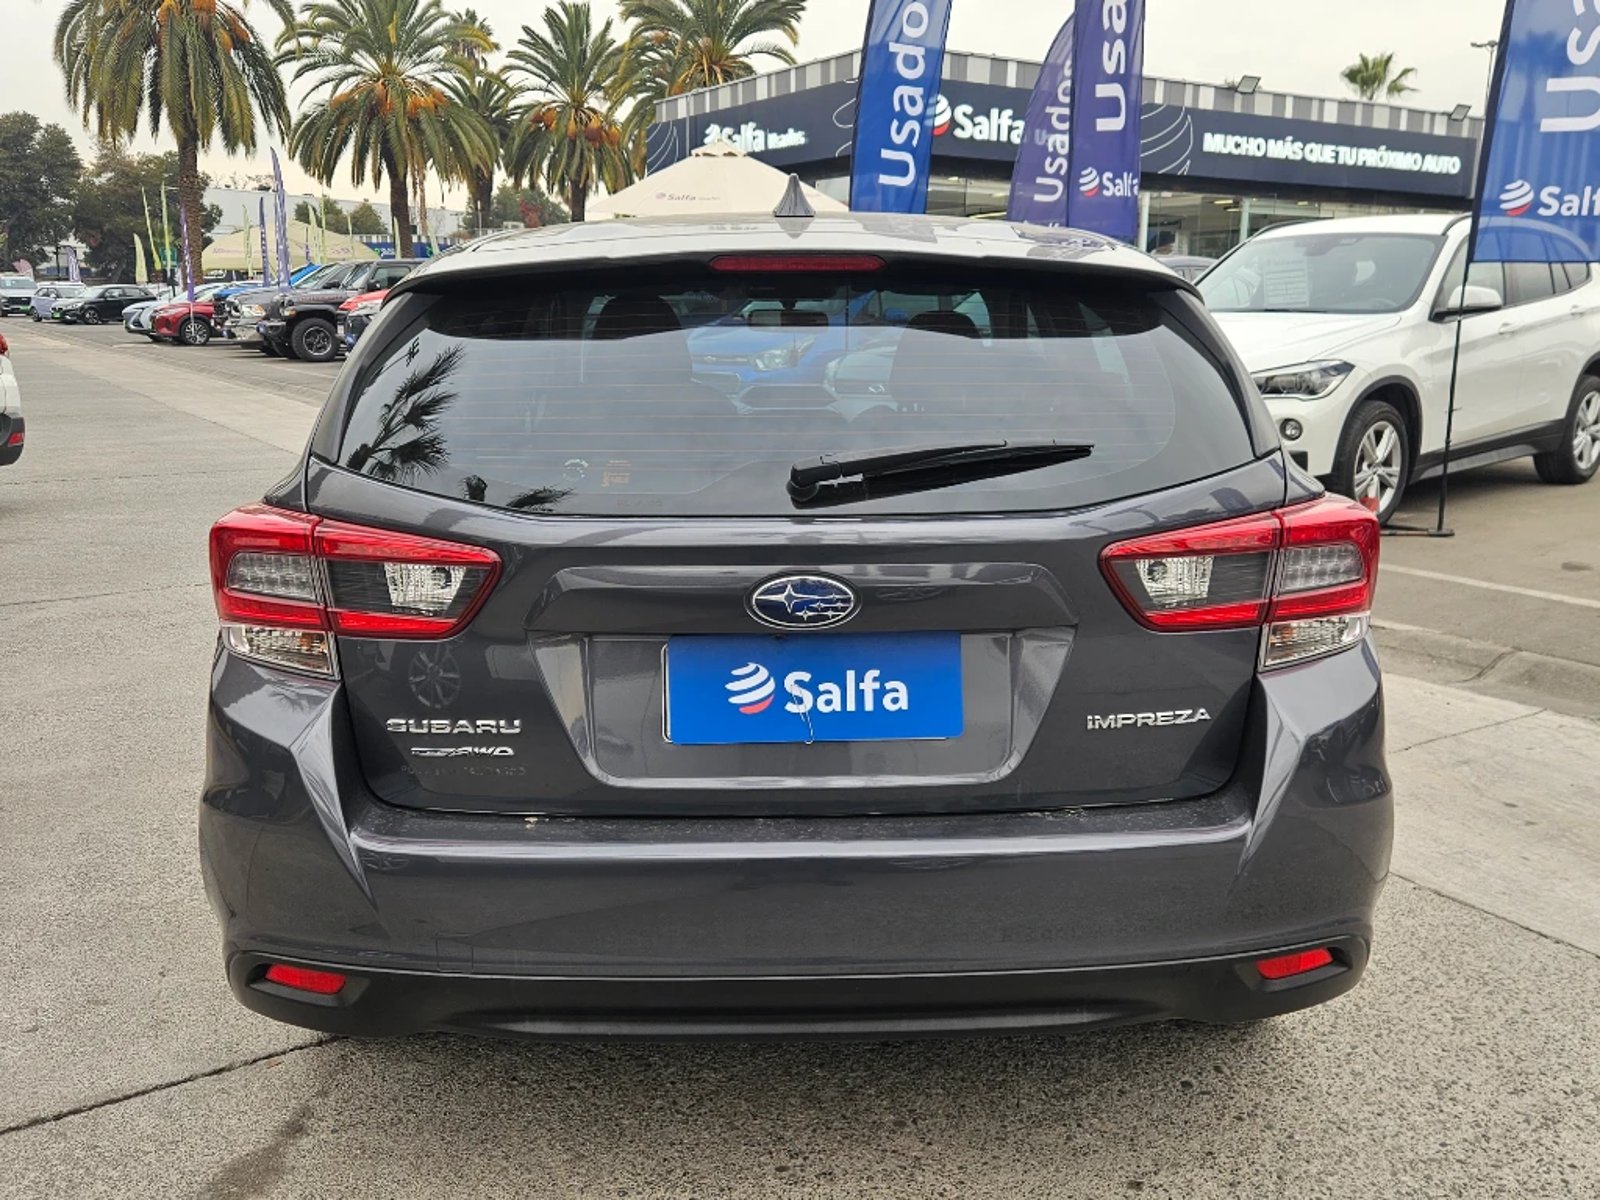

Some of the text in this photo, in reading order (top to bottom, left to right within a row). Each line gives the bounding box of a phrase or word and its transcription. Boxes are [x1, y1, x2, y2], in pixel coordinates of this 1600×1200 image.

[878, 1, 929, 187] Usado
[953, 103, 1025, 144] Salfa
[1202, 132, 1461, 174] MUCHO MÁS QUE TU PRÓXIMO AUTO
[783, 669, 909, 713] Salfa
[386, 718, 521, 734] SUBARU
[1086, 707, 1212, 731] IMPREZA
